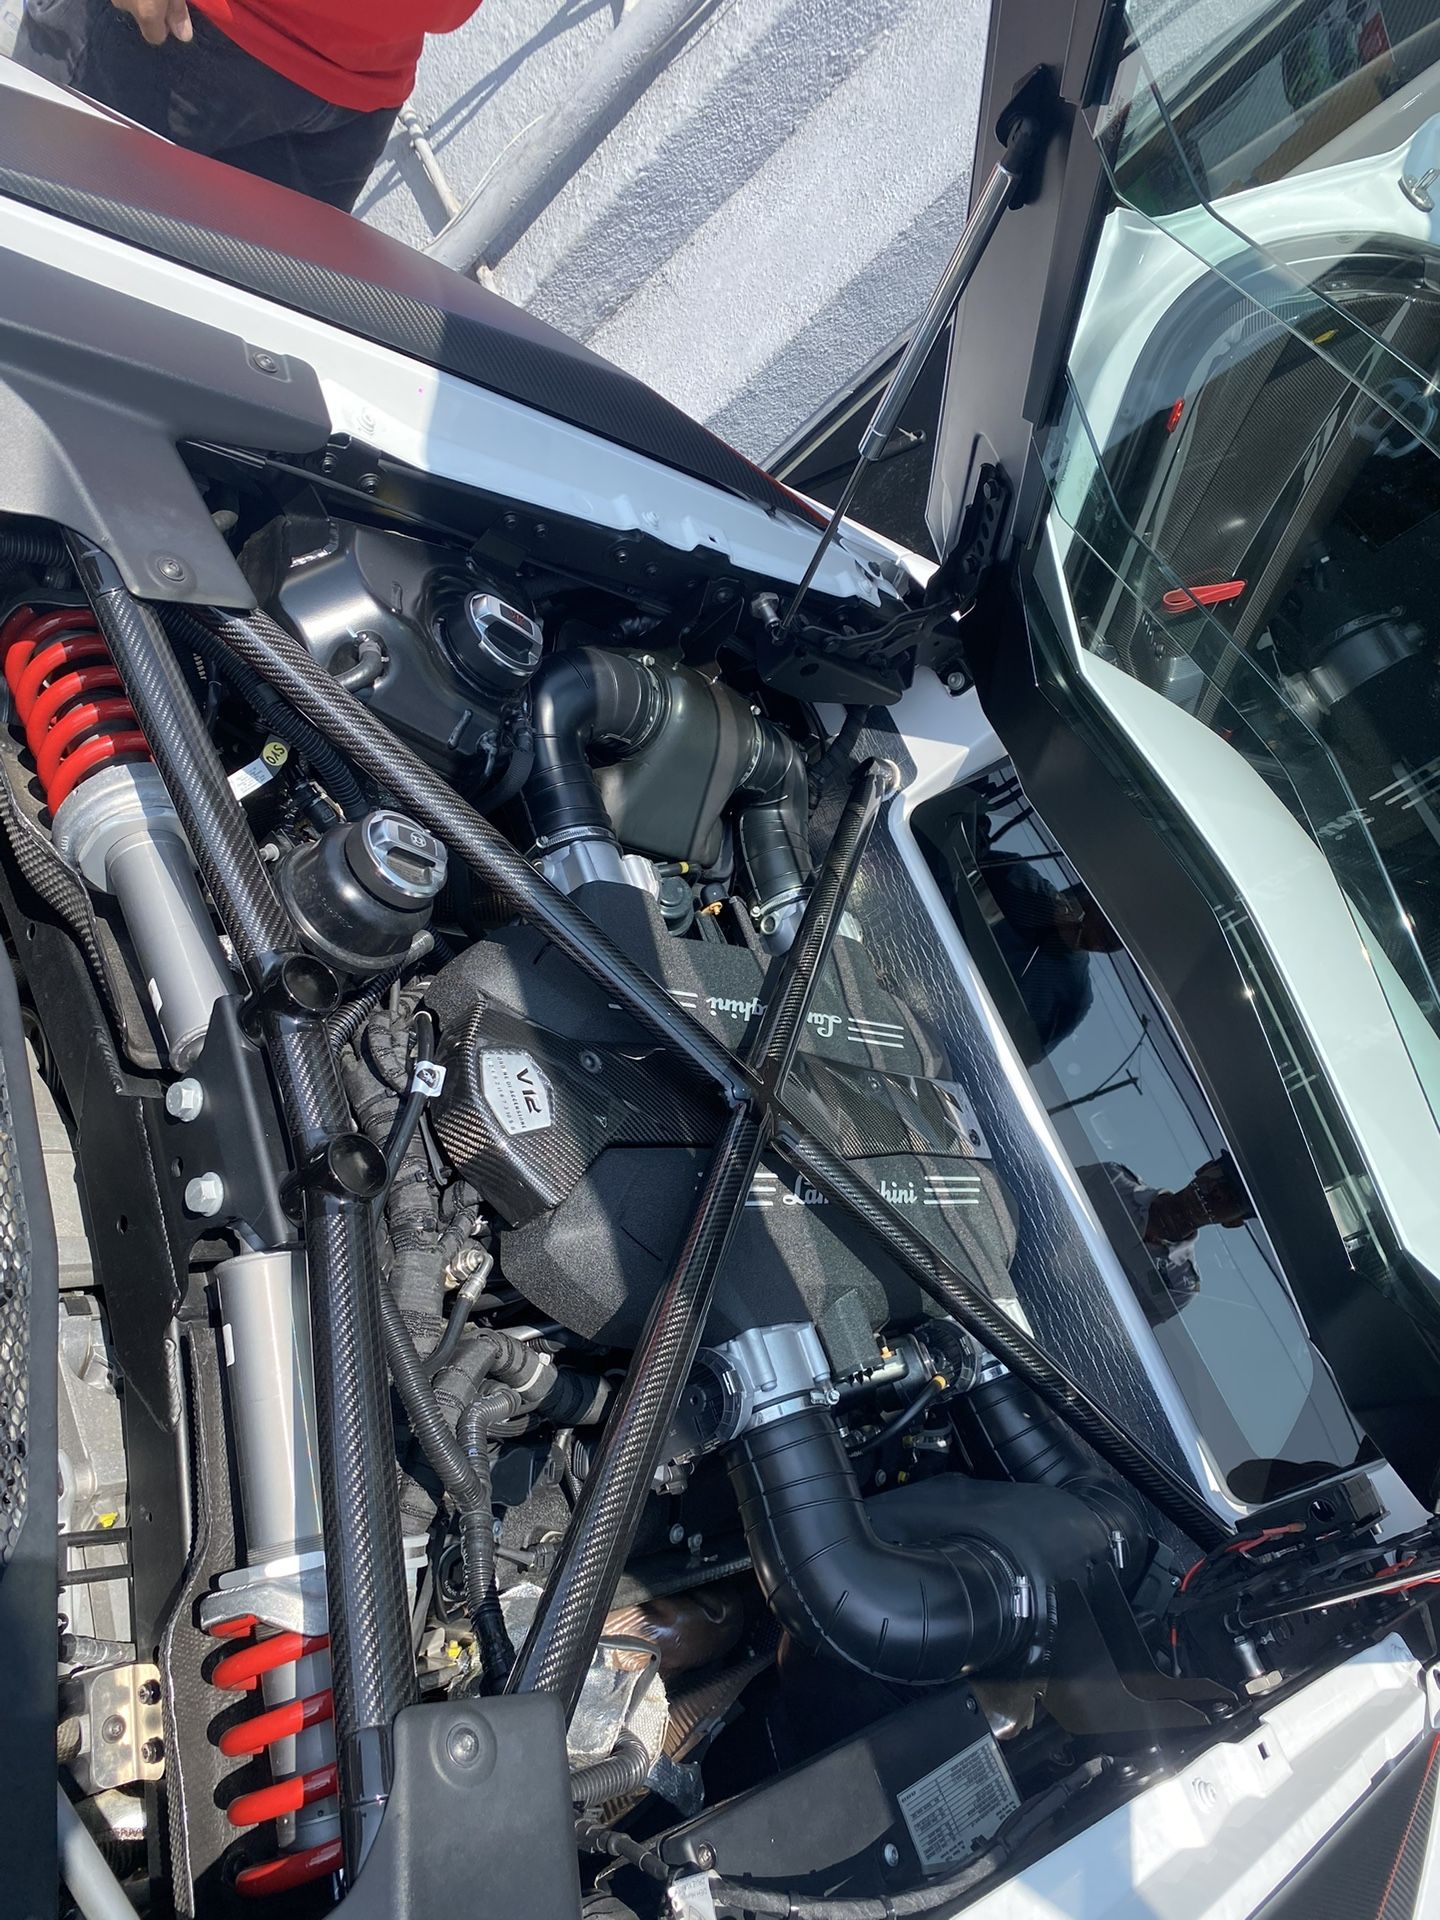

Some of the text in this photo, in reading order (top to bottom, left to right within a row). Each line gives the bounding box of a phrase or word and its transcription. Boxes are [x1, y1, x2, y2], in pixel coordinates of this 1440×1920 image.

[706, 997, 842, 1037] Laghini
[516, 1067, 542, 1113] V12
[783, 1175, 917, 1205] Lahini
